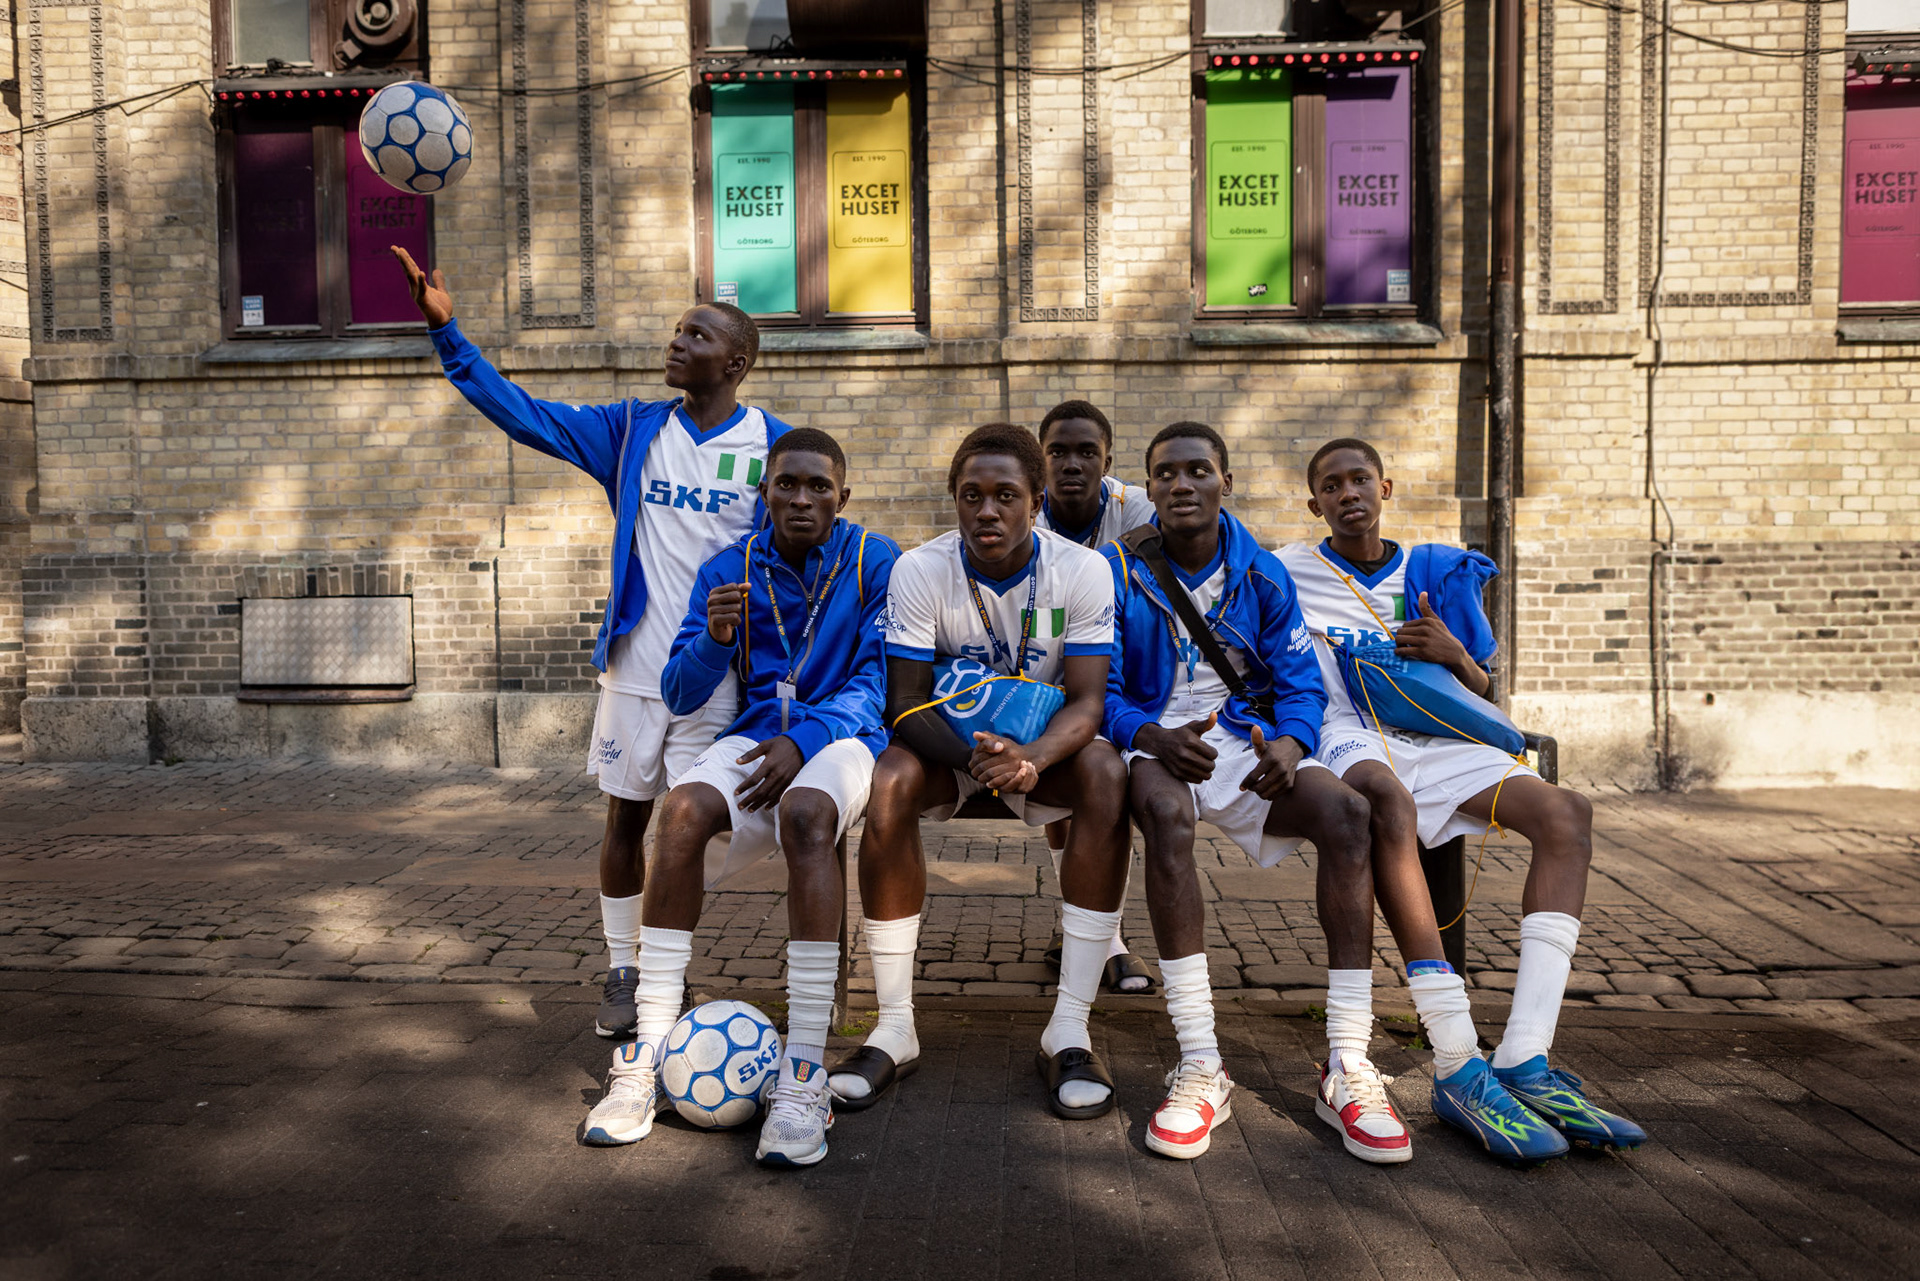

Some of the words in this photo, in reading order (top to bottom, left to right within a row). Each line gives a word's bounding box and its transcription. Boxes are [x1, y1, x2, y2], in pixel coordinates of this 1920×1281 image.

[1218, 174, 1279, 190] EXCET
[1338, 174, 1399, 190] EXCET
[1855, 171, 1918, 187] EXCET
[726, 185, 784, 201] EXCET
[841, 183, 900, 199] EXCET
[1855, 189, 1917, 204] HUSET
[360, 196, 415, 212] EXCET
[1218, 192, 1279, 207] HUSET
[1338, 192, 1399, 207] HUSET
[726, 202, 784, 217] HUSET
[841, 201, 900, 216] HUSET
[360, 213, 416, 228] HUSET
[1229, 227, 1268, 235] GÖTEBORG
[852, 236, 889, 244] GÖTEBORG
[644, 479, 740, 514] SKF
[767, 584, 776, 604] WORLD
[773, 605, 781, 624] YOUTH
[974, 590, 983, 610] YOUTH
[802, 617, 814, 638] GOTHIA
[811, 605, 819, 616] CUP
[819, 581, 831, 600] WORLD
[980, 609, 990, 629] WORLD
[1023, 617, 1031, 637] WORLD
[1167, 619, 1177, 638] YOUTH
[989, 691, 1013, 723] PRESENTED
[1011, 685, 1018, 693] BY
[737, 1039, 777, 1084] SKF
[1064, 1051, 1094, 1064] NIKE
